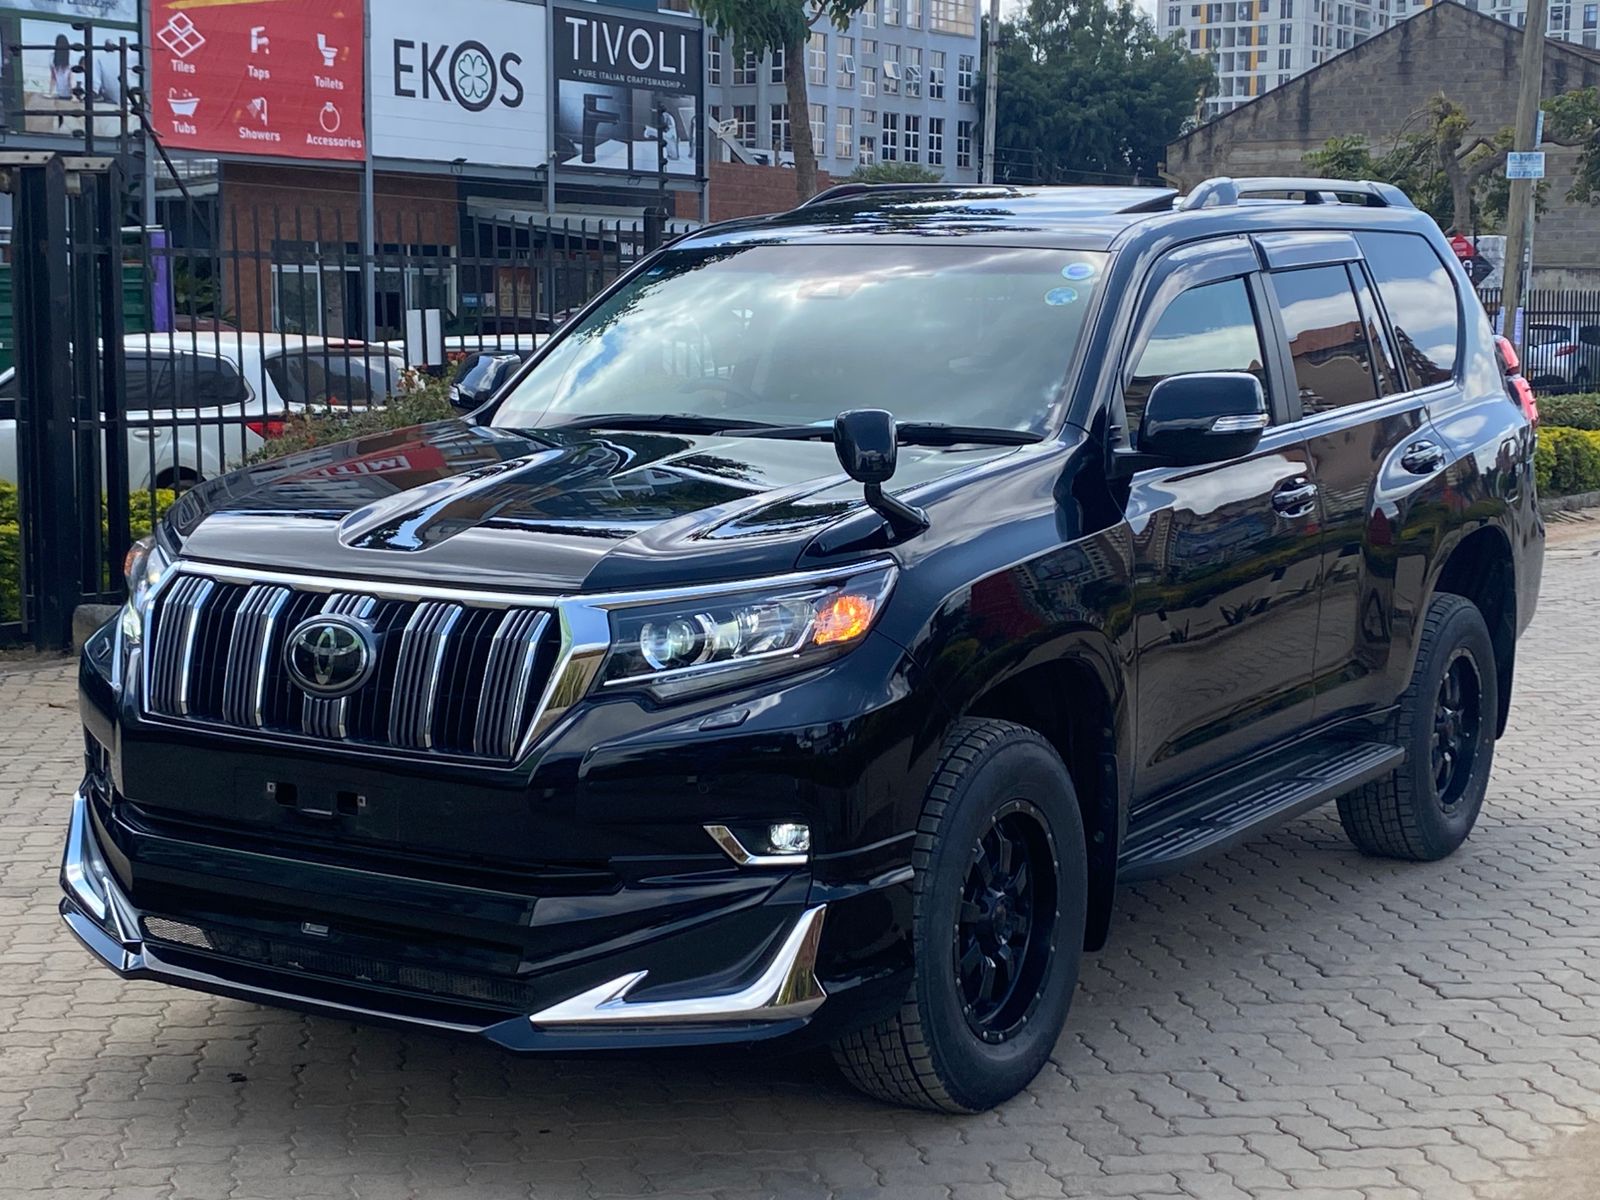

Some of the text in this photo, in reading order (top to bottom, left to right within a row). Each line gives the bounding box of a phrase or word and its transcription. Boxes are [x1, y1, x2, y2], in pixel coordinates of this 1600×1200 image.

[565, 16, 686, 75] TIVOLI
[171, 59, 196, 74] Tiles
[247, 65, 270, 80] Taps
[314, 75, 344, 90] Toilets
[393, 38, 524, 112] EKOS
[578, 68, 681, 89] PURE ITALIAN CRAFTSMANSHIP
[172, 120, 197, 134] Tubs
[239, 126, 281, 142] Showers
[306, 132, 362, 149] Accessories
